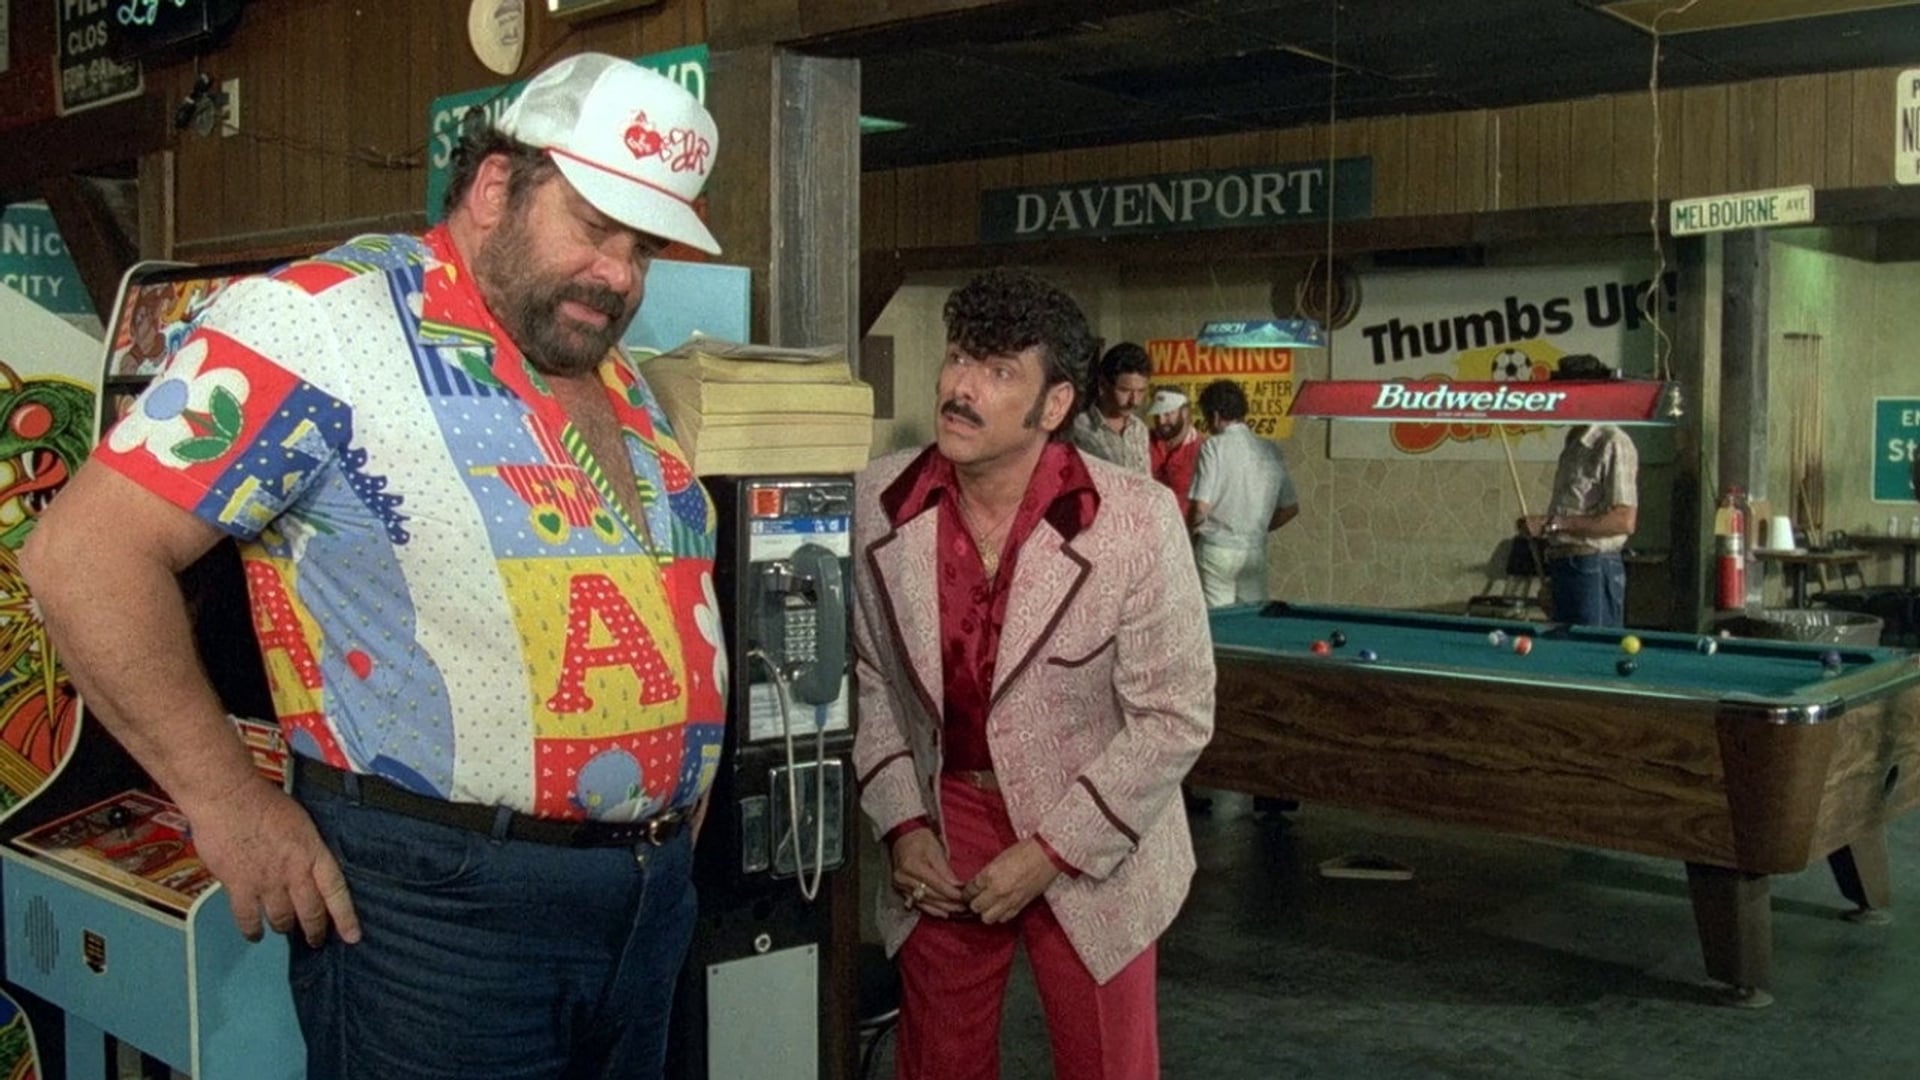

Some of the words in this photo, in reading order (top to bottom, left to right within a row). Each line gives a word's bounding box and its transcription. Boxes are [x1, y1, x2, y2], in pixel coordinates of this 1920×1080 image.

[1014, 168, 1323, 234] DAVENPORT
[1675, 196, 1779, 230] MELBOURNE
[1786, 197, 1806, 211] AVE
[2, 222, 70, 256] Nic
[1362, 296, 1574, 365] Thumbs
[1585, 271, 1677, 330] Up!
[1150, 341, 1289, 374] WARNING
[1254, 380, 1293, 397] AFTER
[1373, 383, 1567, 411] Budweiser
[1250, 399, 1284, 416] DLES
[546, 573, 682, 714] A
